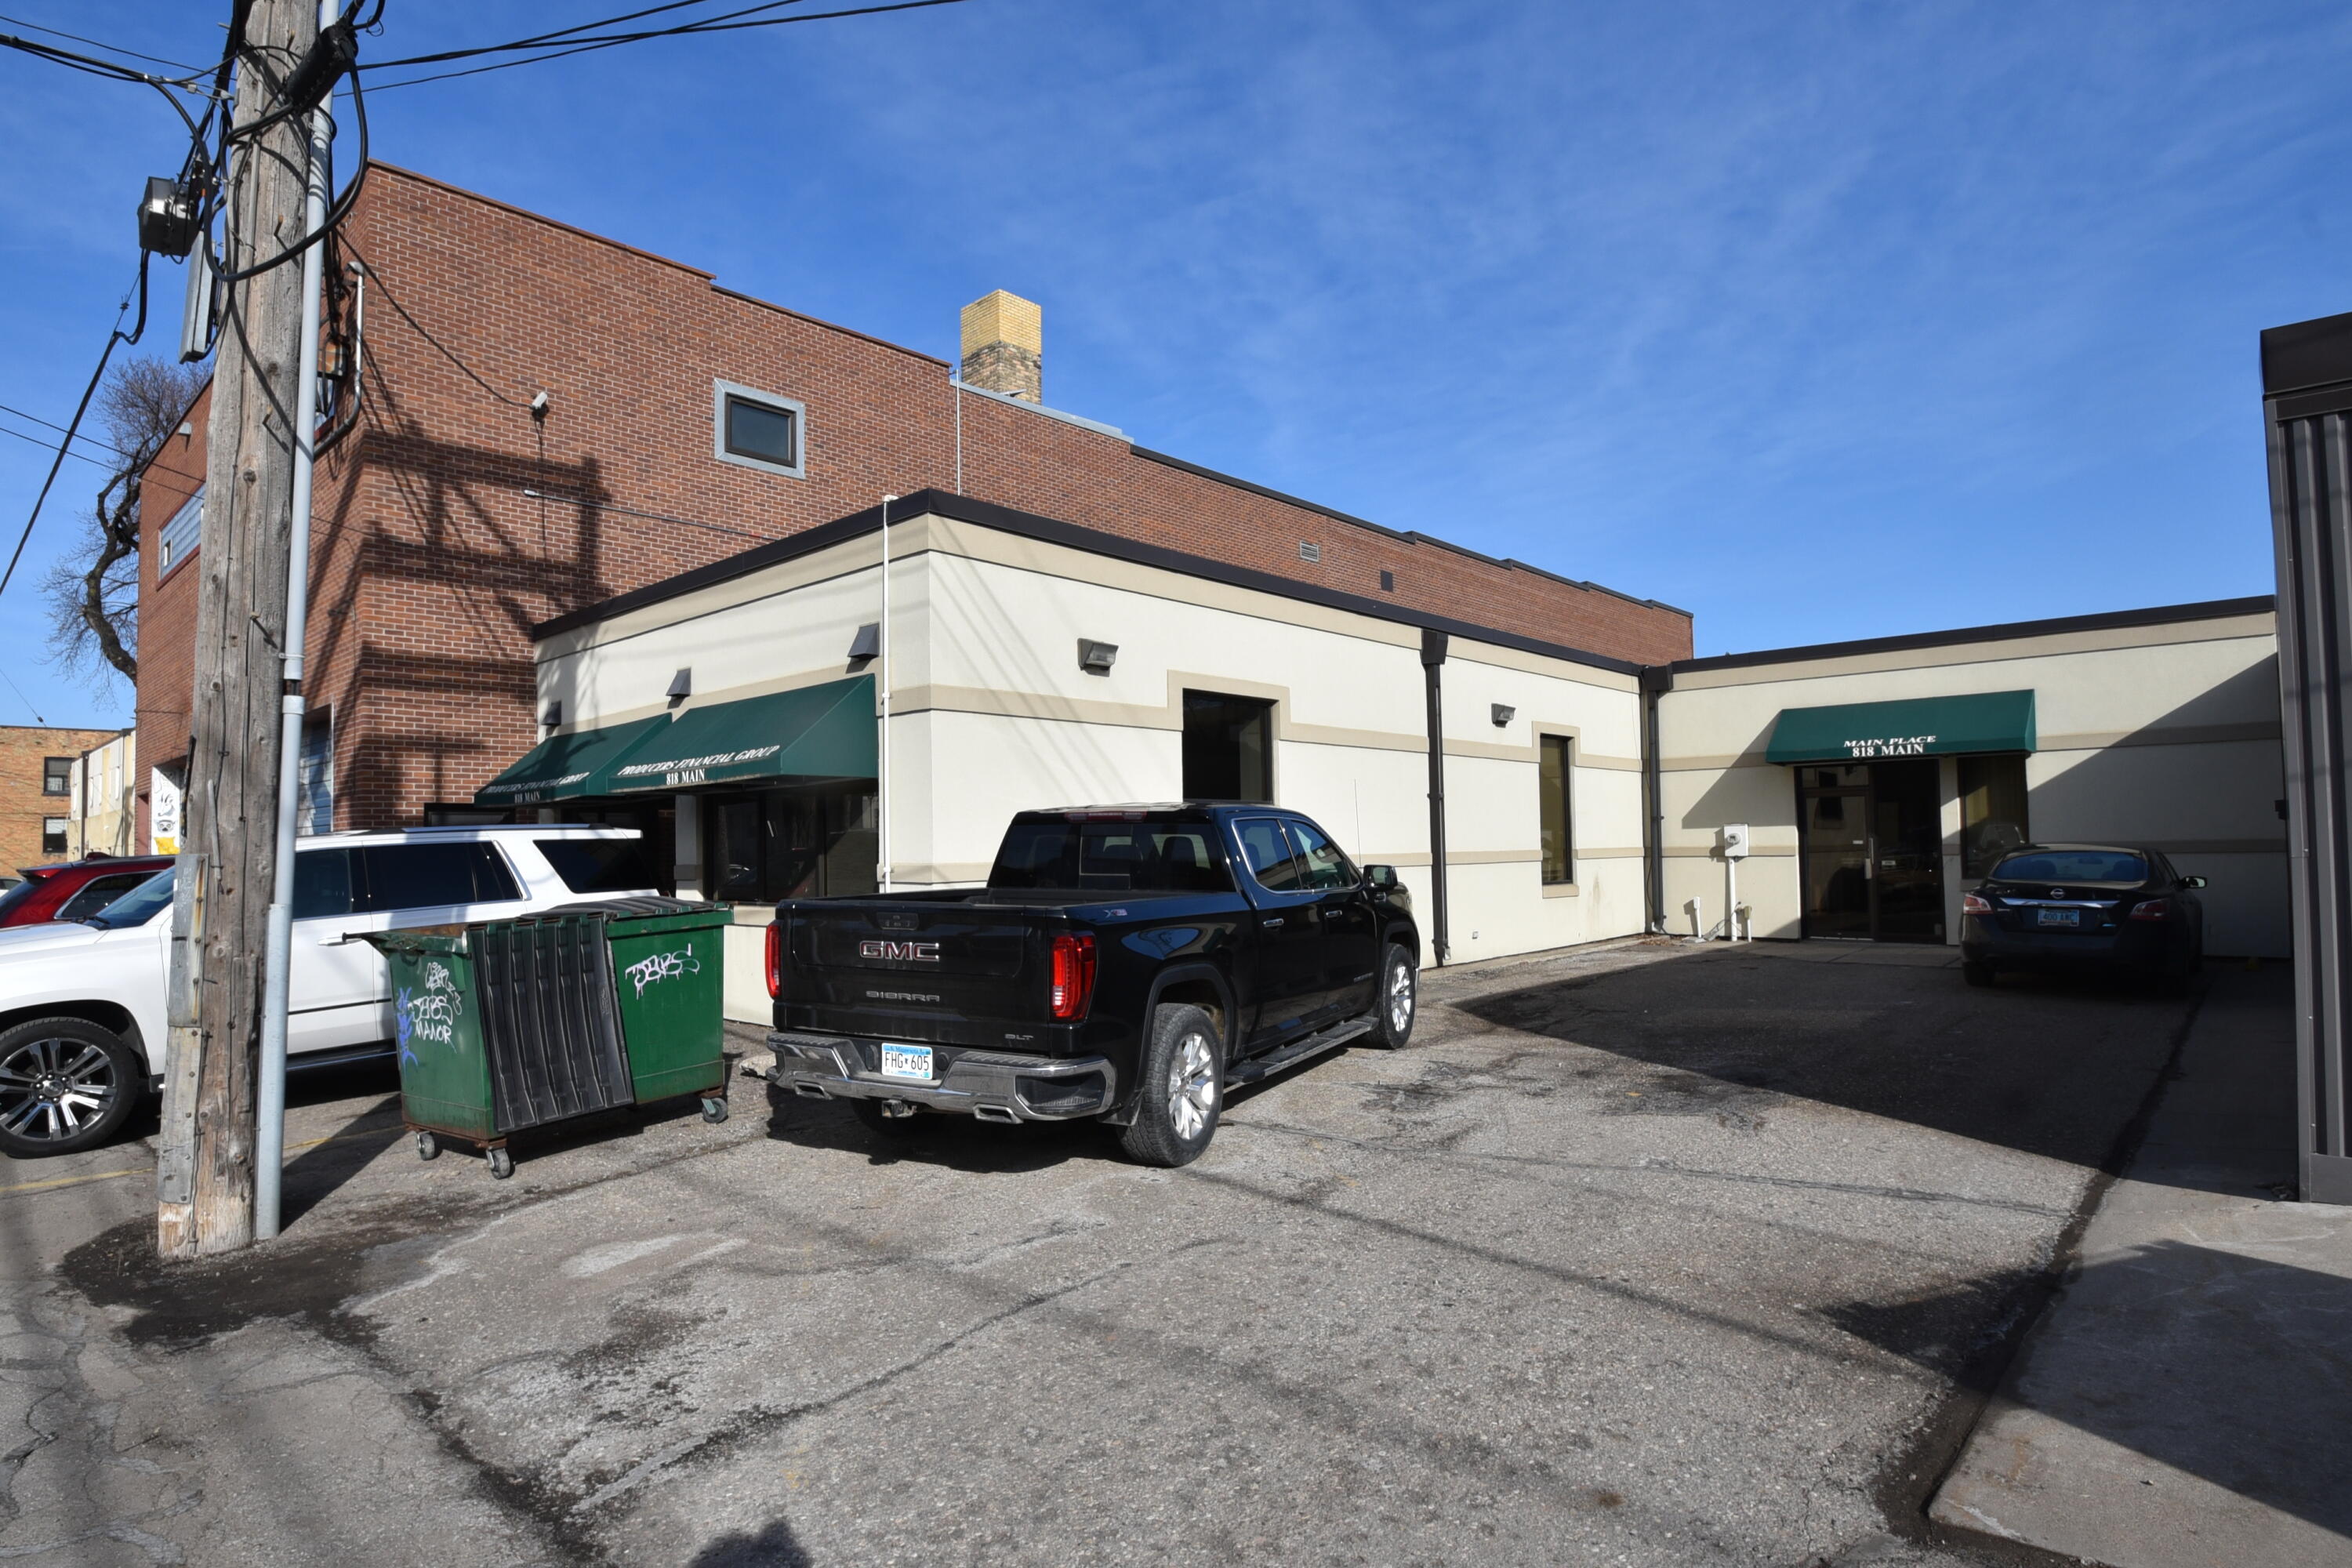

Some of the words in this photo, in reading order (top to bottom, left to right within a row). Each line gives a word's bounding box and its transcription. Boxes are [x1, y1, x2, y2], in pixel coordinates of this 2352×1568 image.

[1844, 739, 1884, 747] MAIN
[1889, 735, 1936, 745] PLACE
[1853, 746, 1875, 757] 818
[1881, 743, 1924, 756] MAIN
[617, 760, 678, 775] PRODUCERS
[675, 752, 736, 769] FINANCIAL
[734, 745, 780, 761] GROUP
[666, 771, 679, 786] 818
[681, 768, 706, 784] MAIN
[514, 793, 523, 804] 818
[524, 790, 540, 804] MAIN
[860, 941, 939, 962] GMC
[866, 991, 940, 1002] SIERRA
[885, 1051, 903, 1069] FHG
[910, 1054, 929, 1072] 605
